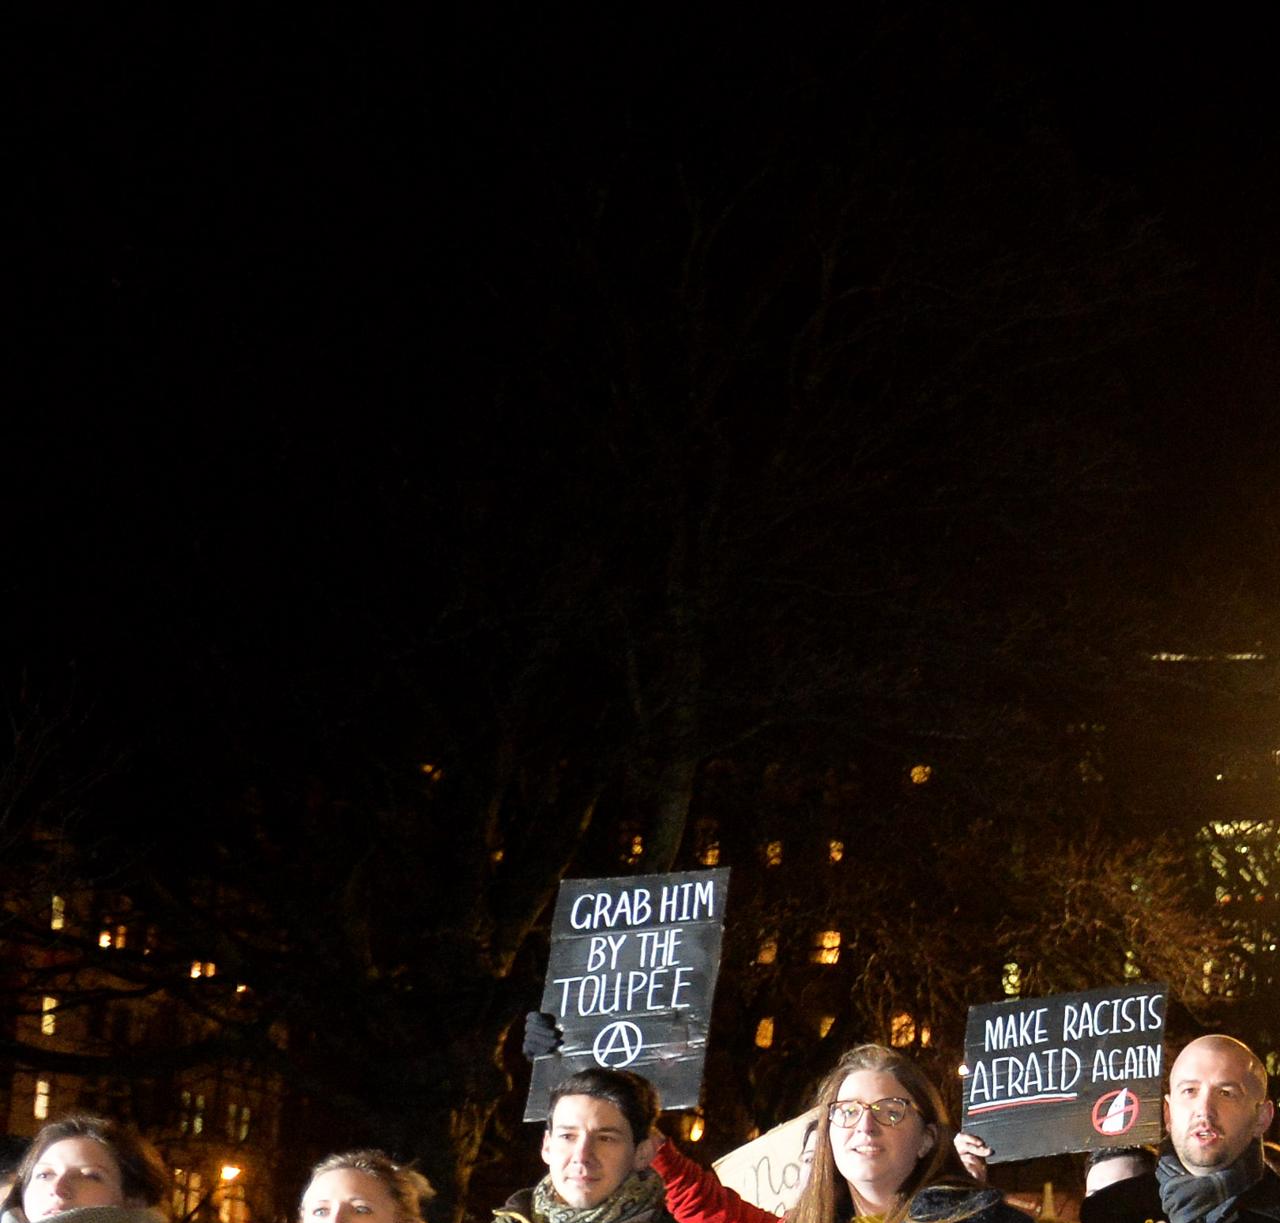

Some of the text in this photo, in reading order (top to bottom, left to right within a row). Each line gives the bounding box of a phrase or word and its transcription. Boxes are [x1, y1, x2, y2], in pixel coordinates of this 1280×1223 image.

[570, 880, 714, 930] GRAB HIM
[586, 928, 684, 972] BY THE
[985, 994, 1164, 1052] MAKE RACISTS
[969, 1044, 1162, 1103] AFRAID AGAIN
